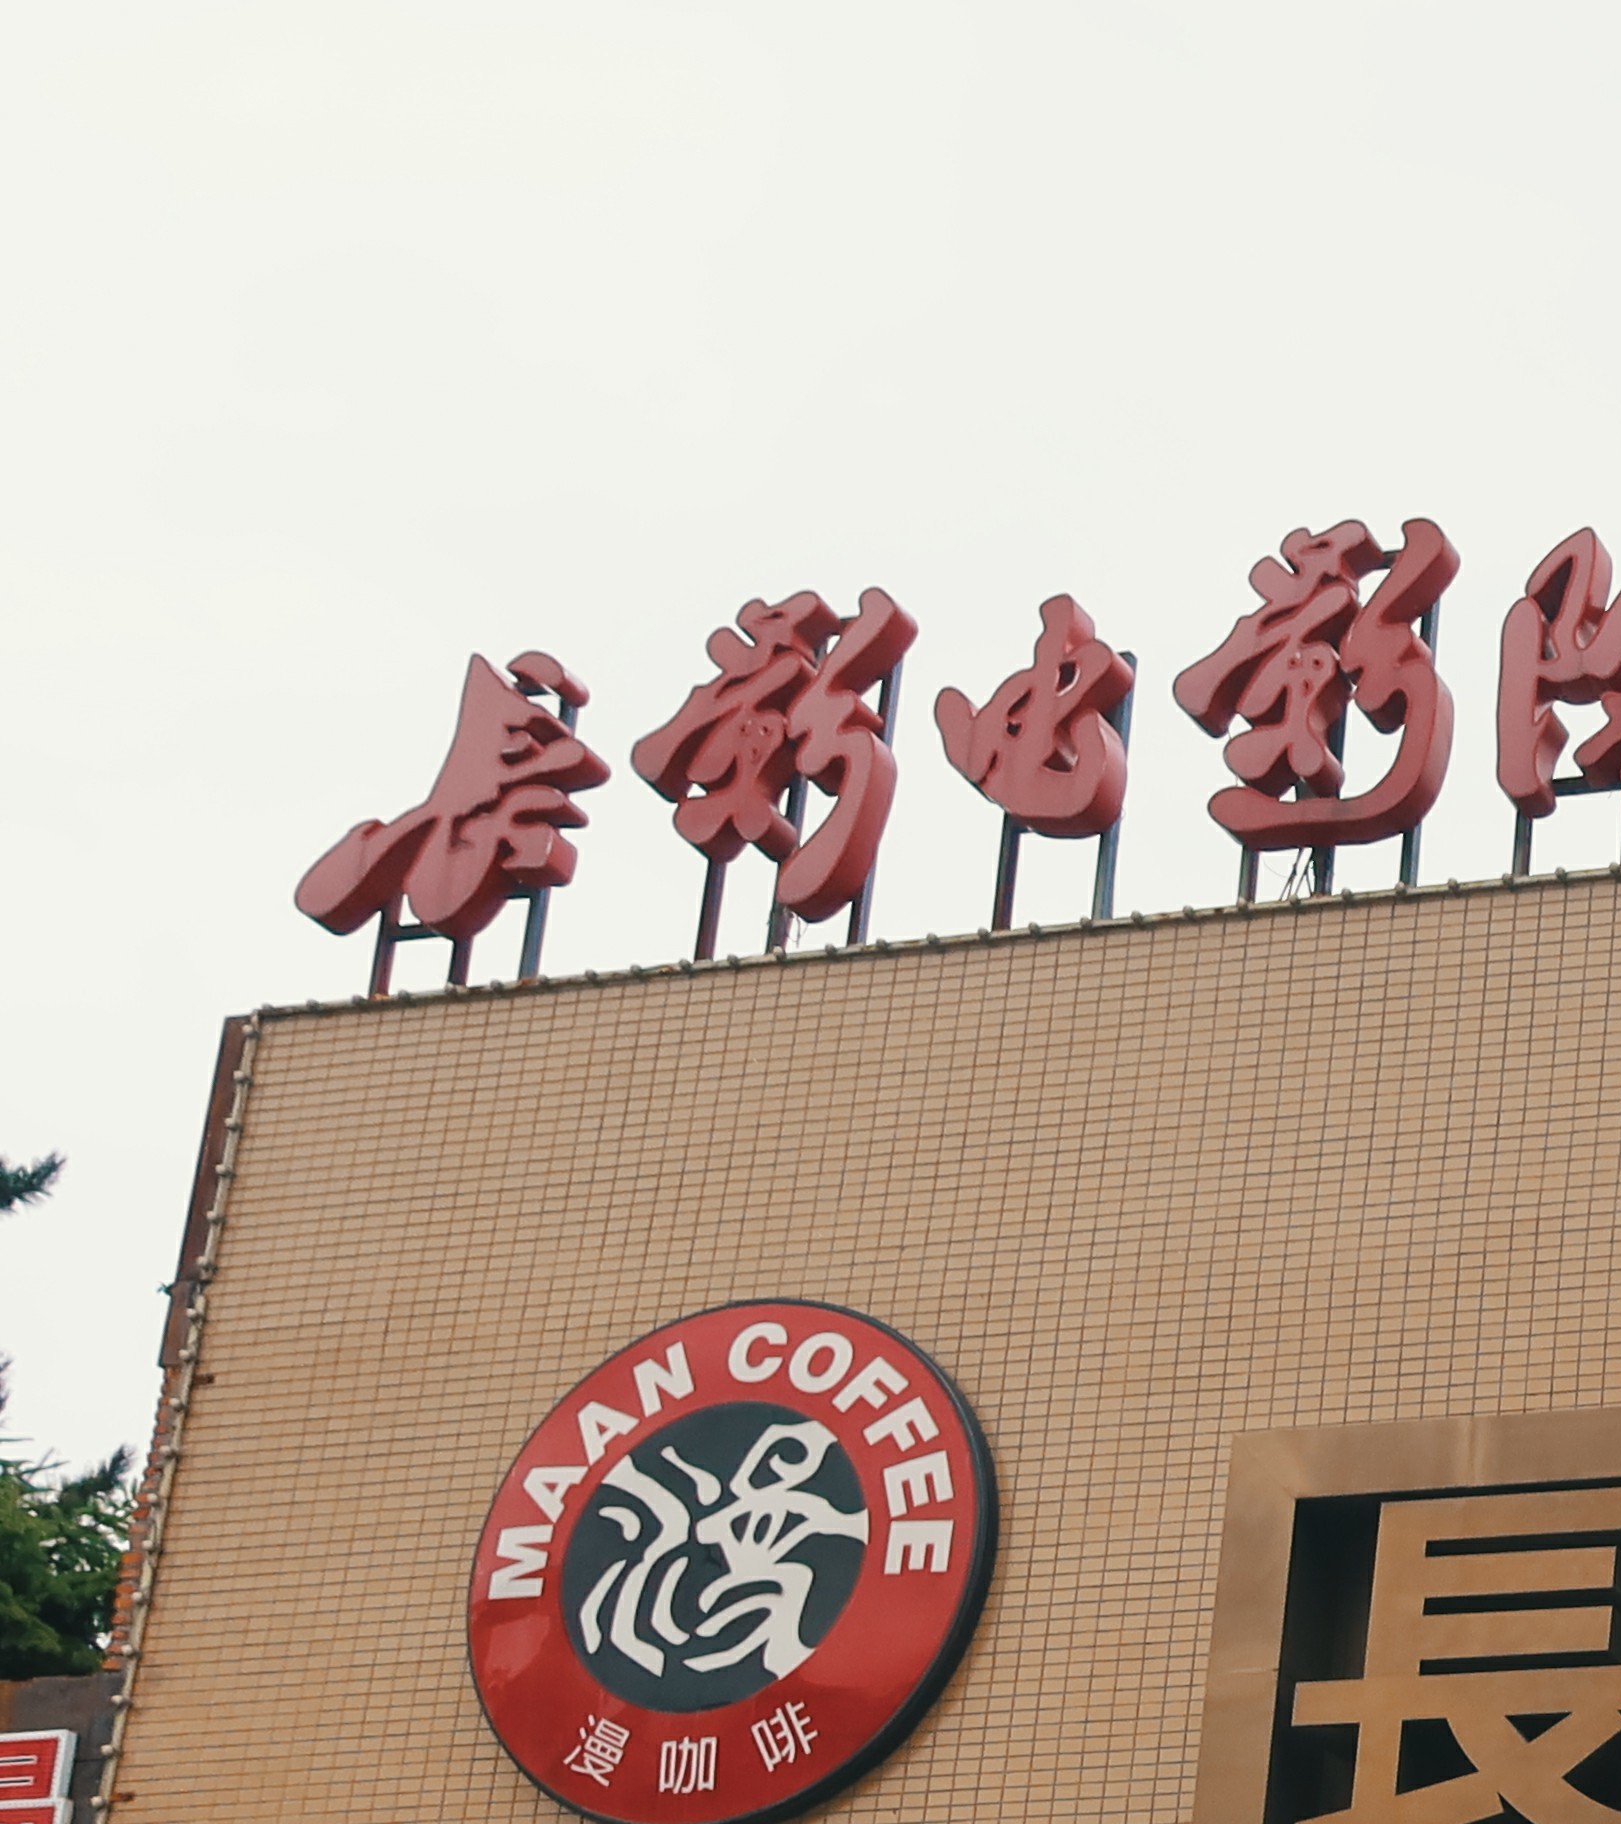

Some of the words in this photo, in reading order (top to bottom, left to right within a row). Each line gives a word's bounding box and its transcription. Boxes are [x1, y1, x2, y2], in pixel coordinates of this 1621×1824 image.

[488, 1340, 695, 1600] MAAN
[727, 1321, 954, 1576] COFFEE
[563, 1701, 818, 1794] 漫咖啡
